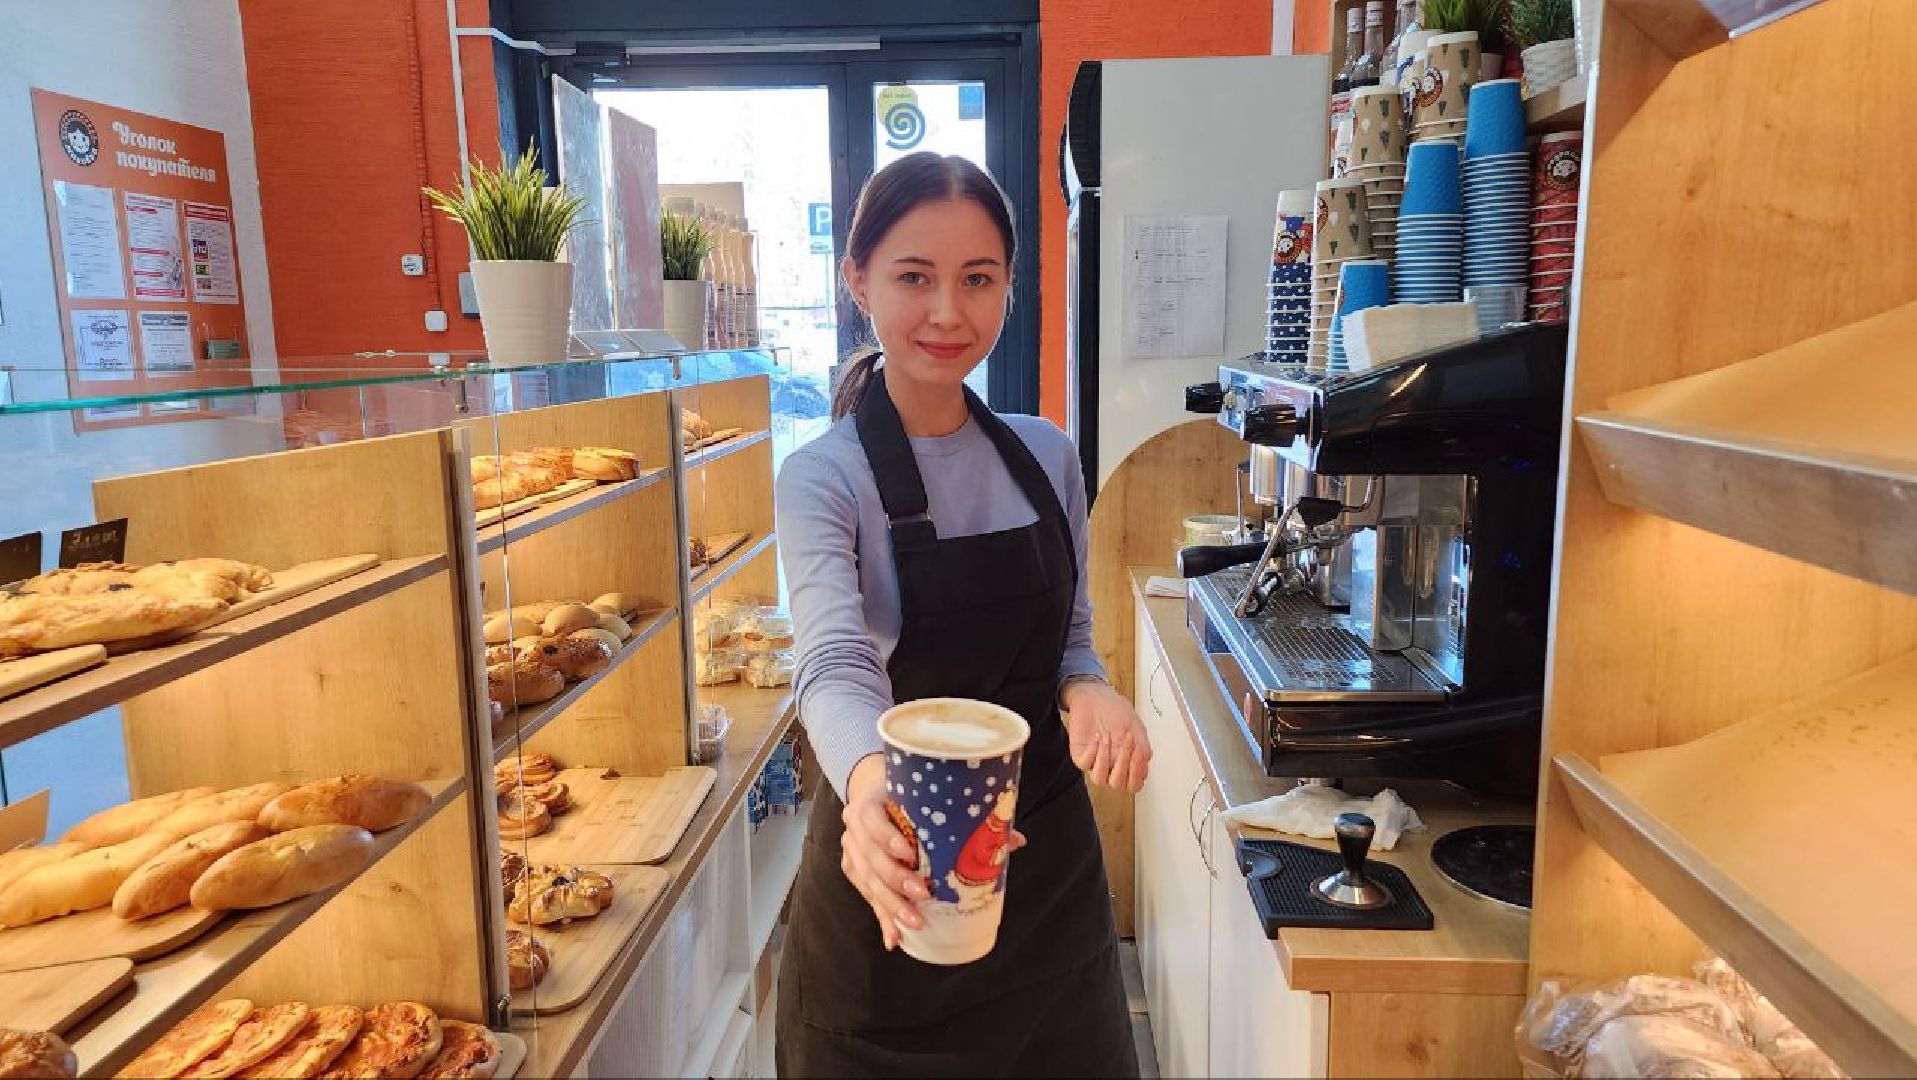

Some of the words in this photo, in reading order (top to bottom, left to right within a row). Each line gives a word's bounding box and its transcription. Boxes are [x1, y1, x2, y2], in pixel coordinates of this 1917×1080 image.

[112, 121, 176, 154] Уголок
[116, 151, 216, 182] покупателя
[816, 207, 832, 233] P
